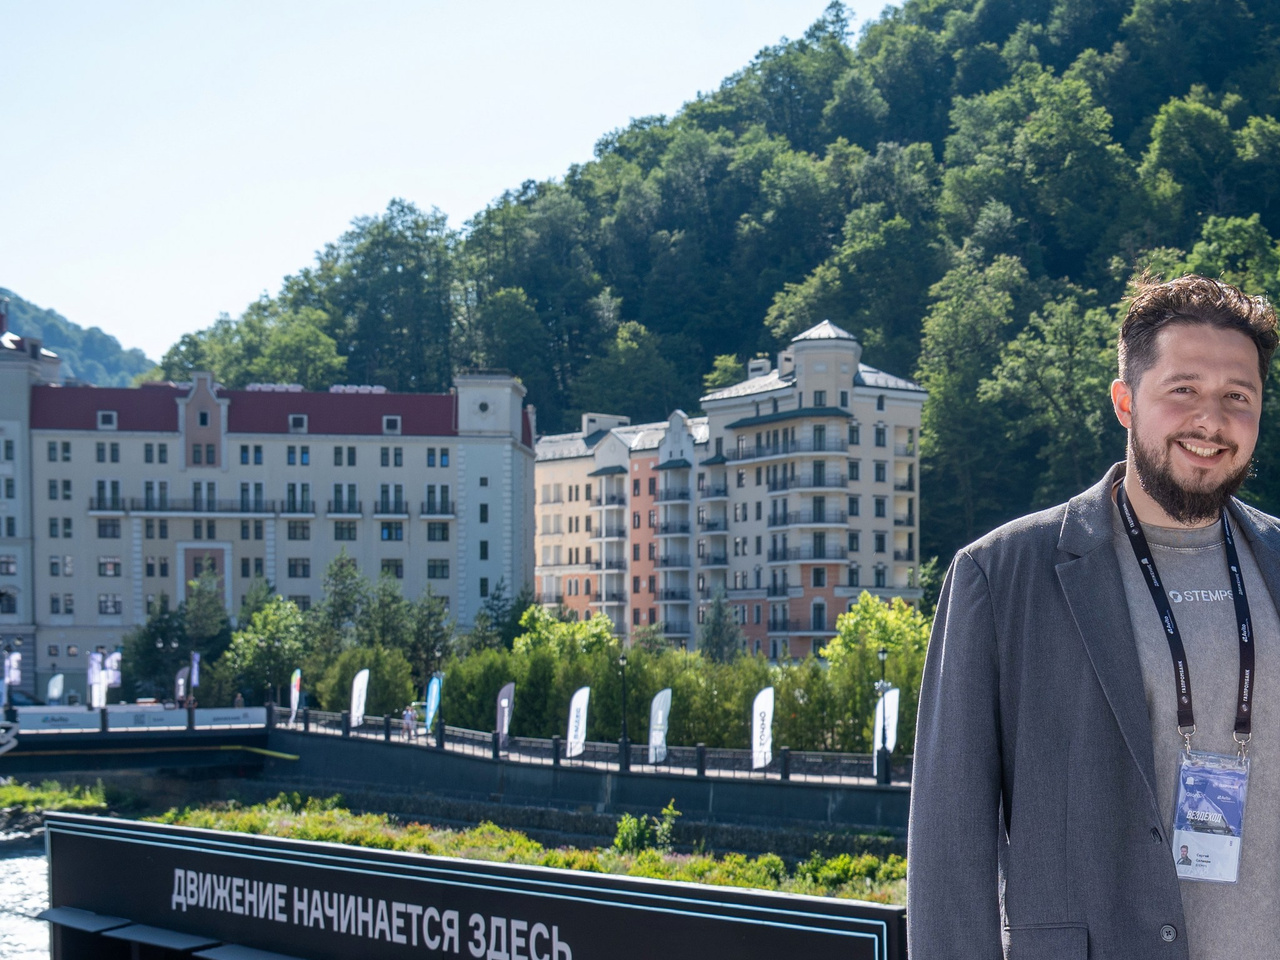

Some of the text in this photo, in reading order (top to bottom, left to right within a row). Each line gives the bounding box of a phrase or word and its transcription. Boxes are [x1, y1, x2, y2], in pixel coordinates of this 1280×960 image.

[1183, 589, 1234, 602] STEMPS
[1178, 660, 1187, 694] ГАЗПРОМБАНК
[1186, 810, 1222, 823] ВЕЗДЕХОД
[172, 868, 287, 923] ДВИЖЕНИЕ
[293, 886, 460, 954] НАЧИНАЕТСЯ
